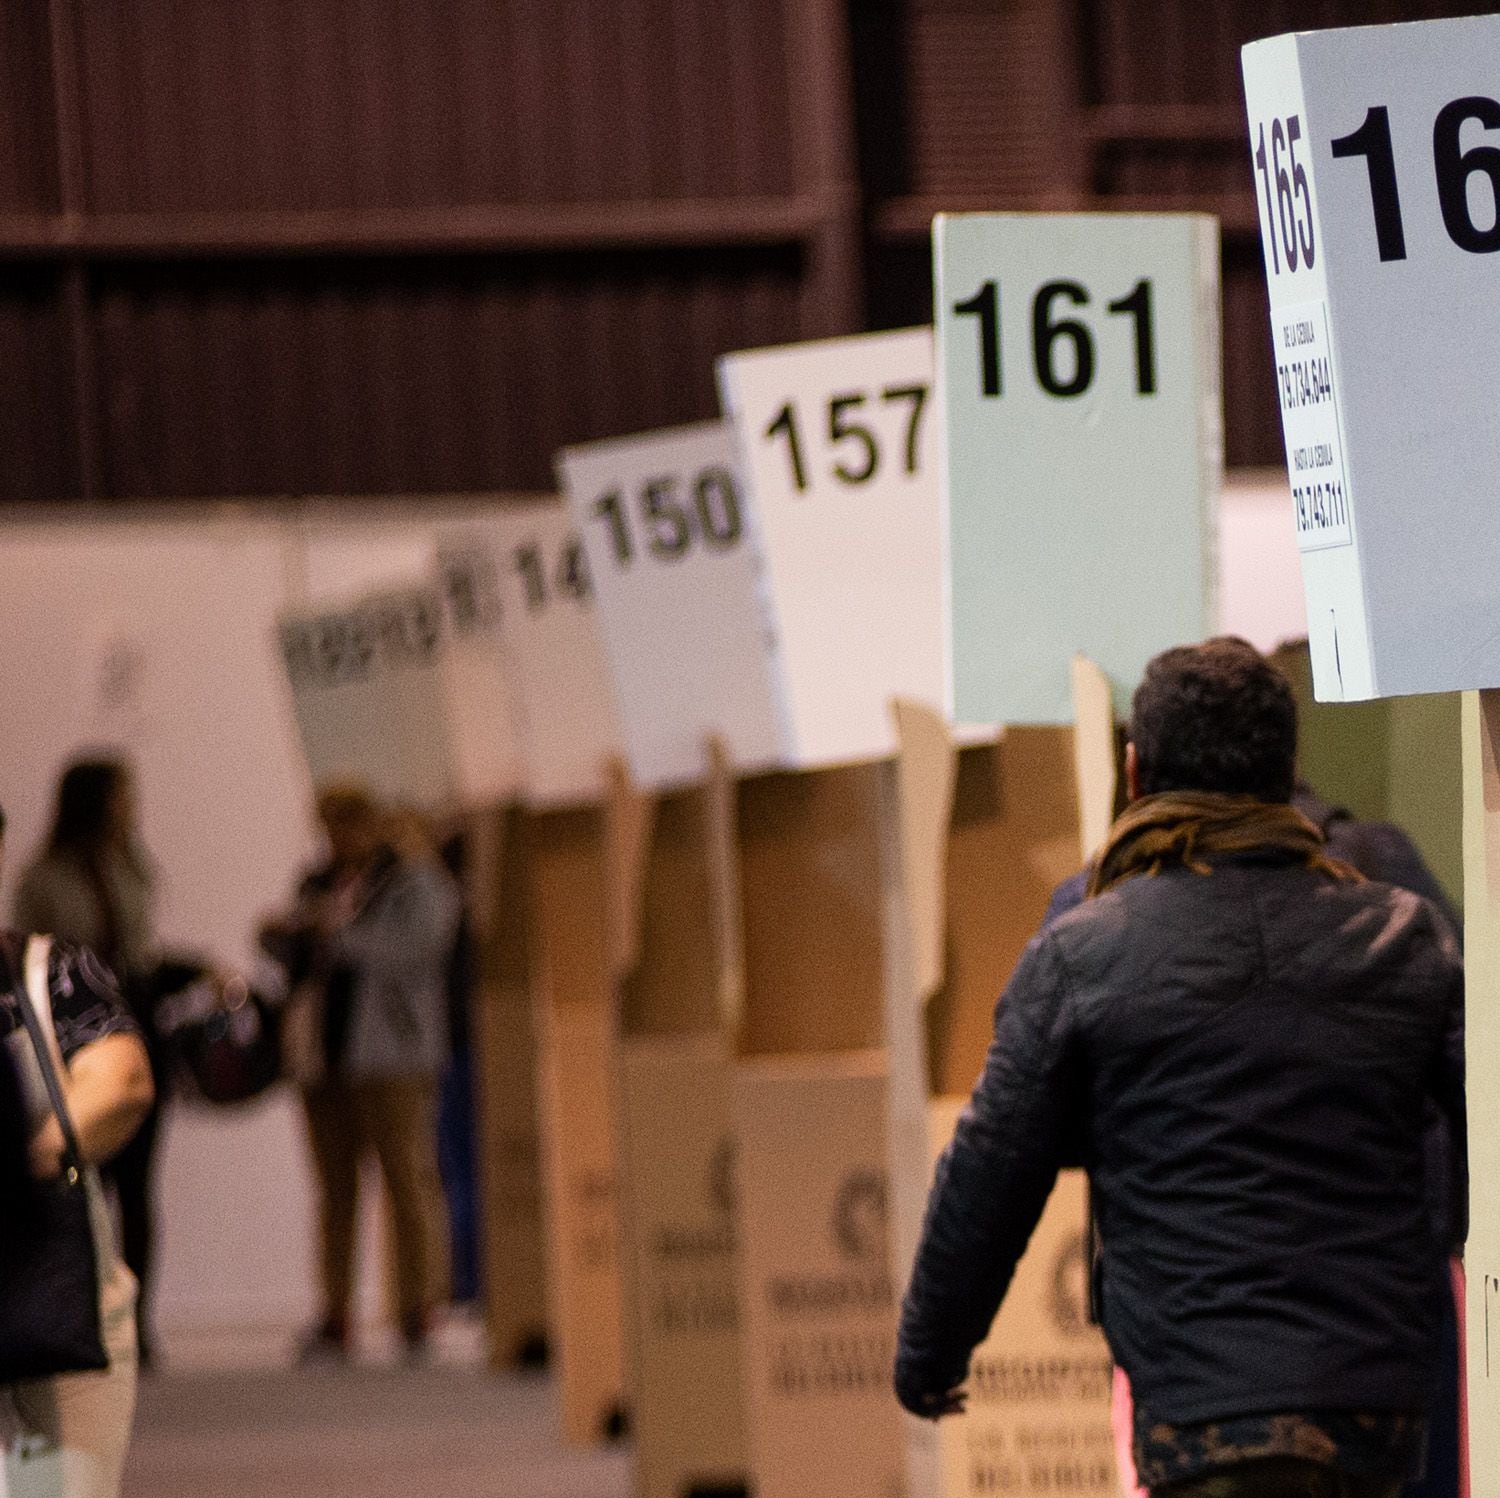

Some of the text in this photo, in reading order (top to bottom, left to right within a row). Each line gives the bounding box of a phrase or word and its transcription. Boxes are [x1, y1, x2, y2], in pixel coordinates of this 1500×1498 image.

[1256, 114, 1316, 275] 165
[954, 278, 1158, 398] 161
[1279, 357, 1332, 410] 79.734.644
[763, 383, 931, 494] 157
[592, 466, 745, 571] 150
[1293, 480, 1345, 532] 79.743.711
[511, 534, 598, 612] 14
